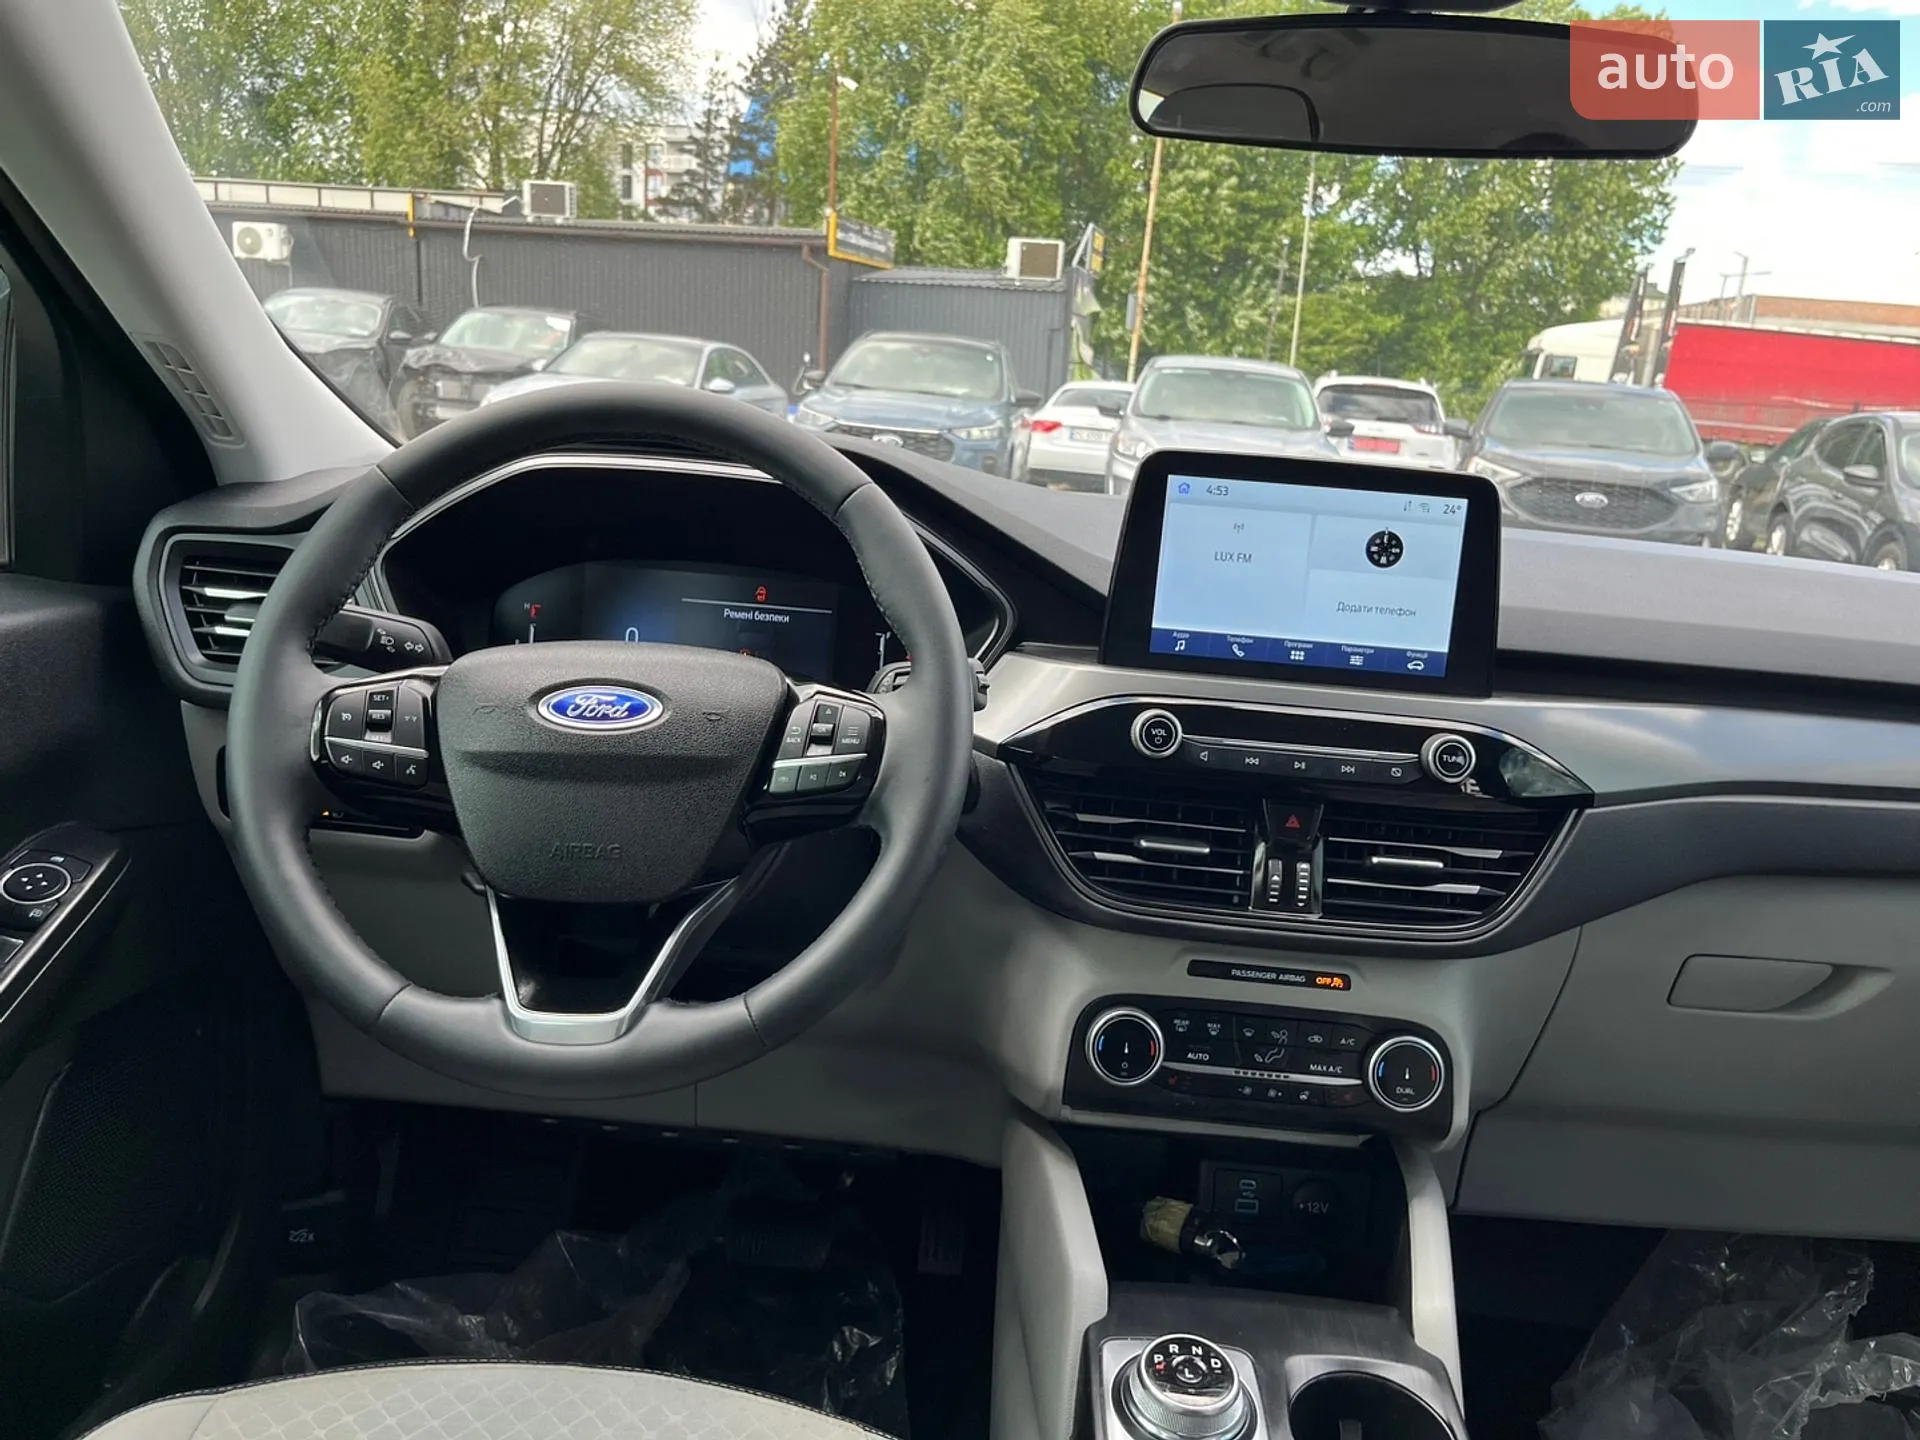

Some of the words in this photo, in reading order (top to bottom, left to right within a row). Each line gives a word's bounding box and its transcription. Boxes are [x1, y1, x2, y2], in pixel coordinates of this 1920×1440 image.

[1206, 485, 1230, 497] 4:53
[1214, 551, 1234, 562] LUX
[1236, 553, 1253, 563] FM
[1336, 600, 1373, 615] Додати
[1374, 605, 1417, 618] телефон
[723, 608, 753, 620] Ремені
[754, 610, 791, 624] безпеки
[566, 693, 632, 719] Ford
[1150, 727, 1168, 736] VOL
[549, 842, 621, 860] AIRBAG
[1231, 969, 1277, 980] PASSENGER
[1278, 974, 1306, 983] AIRBAG
[1187, 1052, 1209, 1061] AUTO
[1310, 1064, 1327, 1072] MAX
[1154, 1354, 1164, 1364] P
[1168, 1344, 1180, 1354] R
[1191, 1345, 1203, 1356] N
[1210, 1358, 1222, 1369] D
[1184, 1368, 1195, 1378] L
